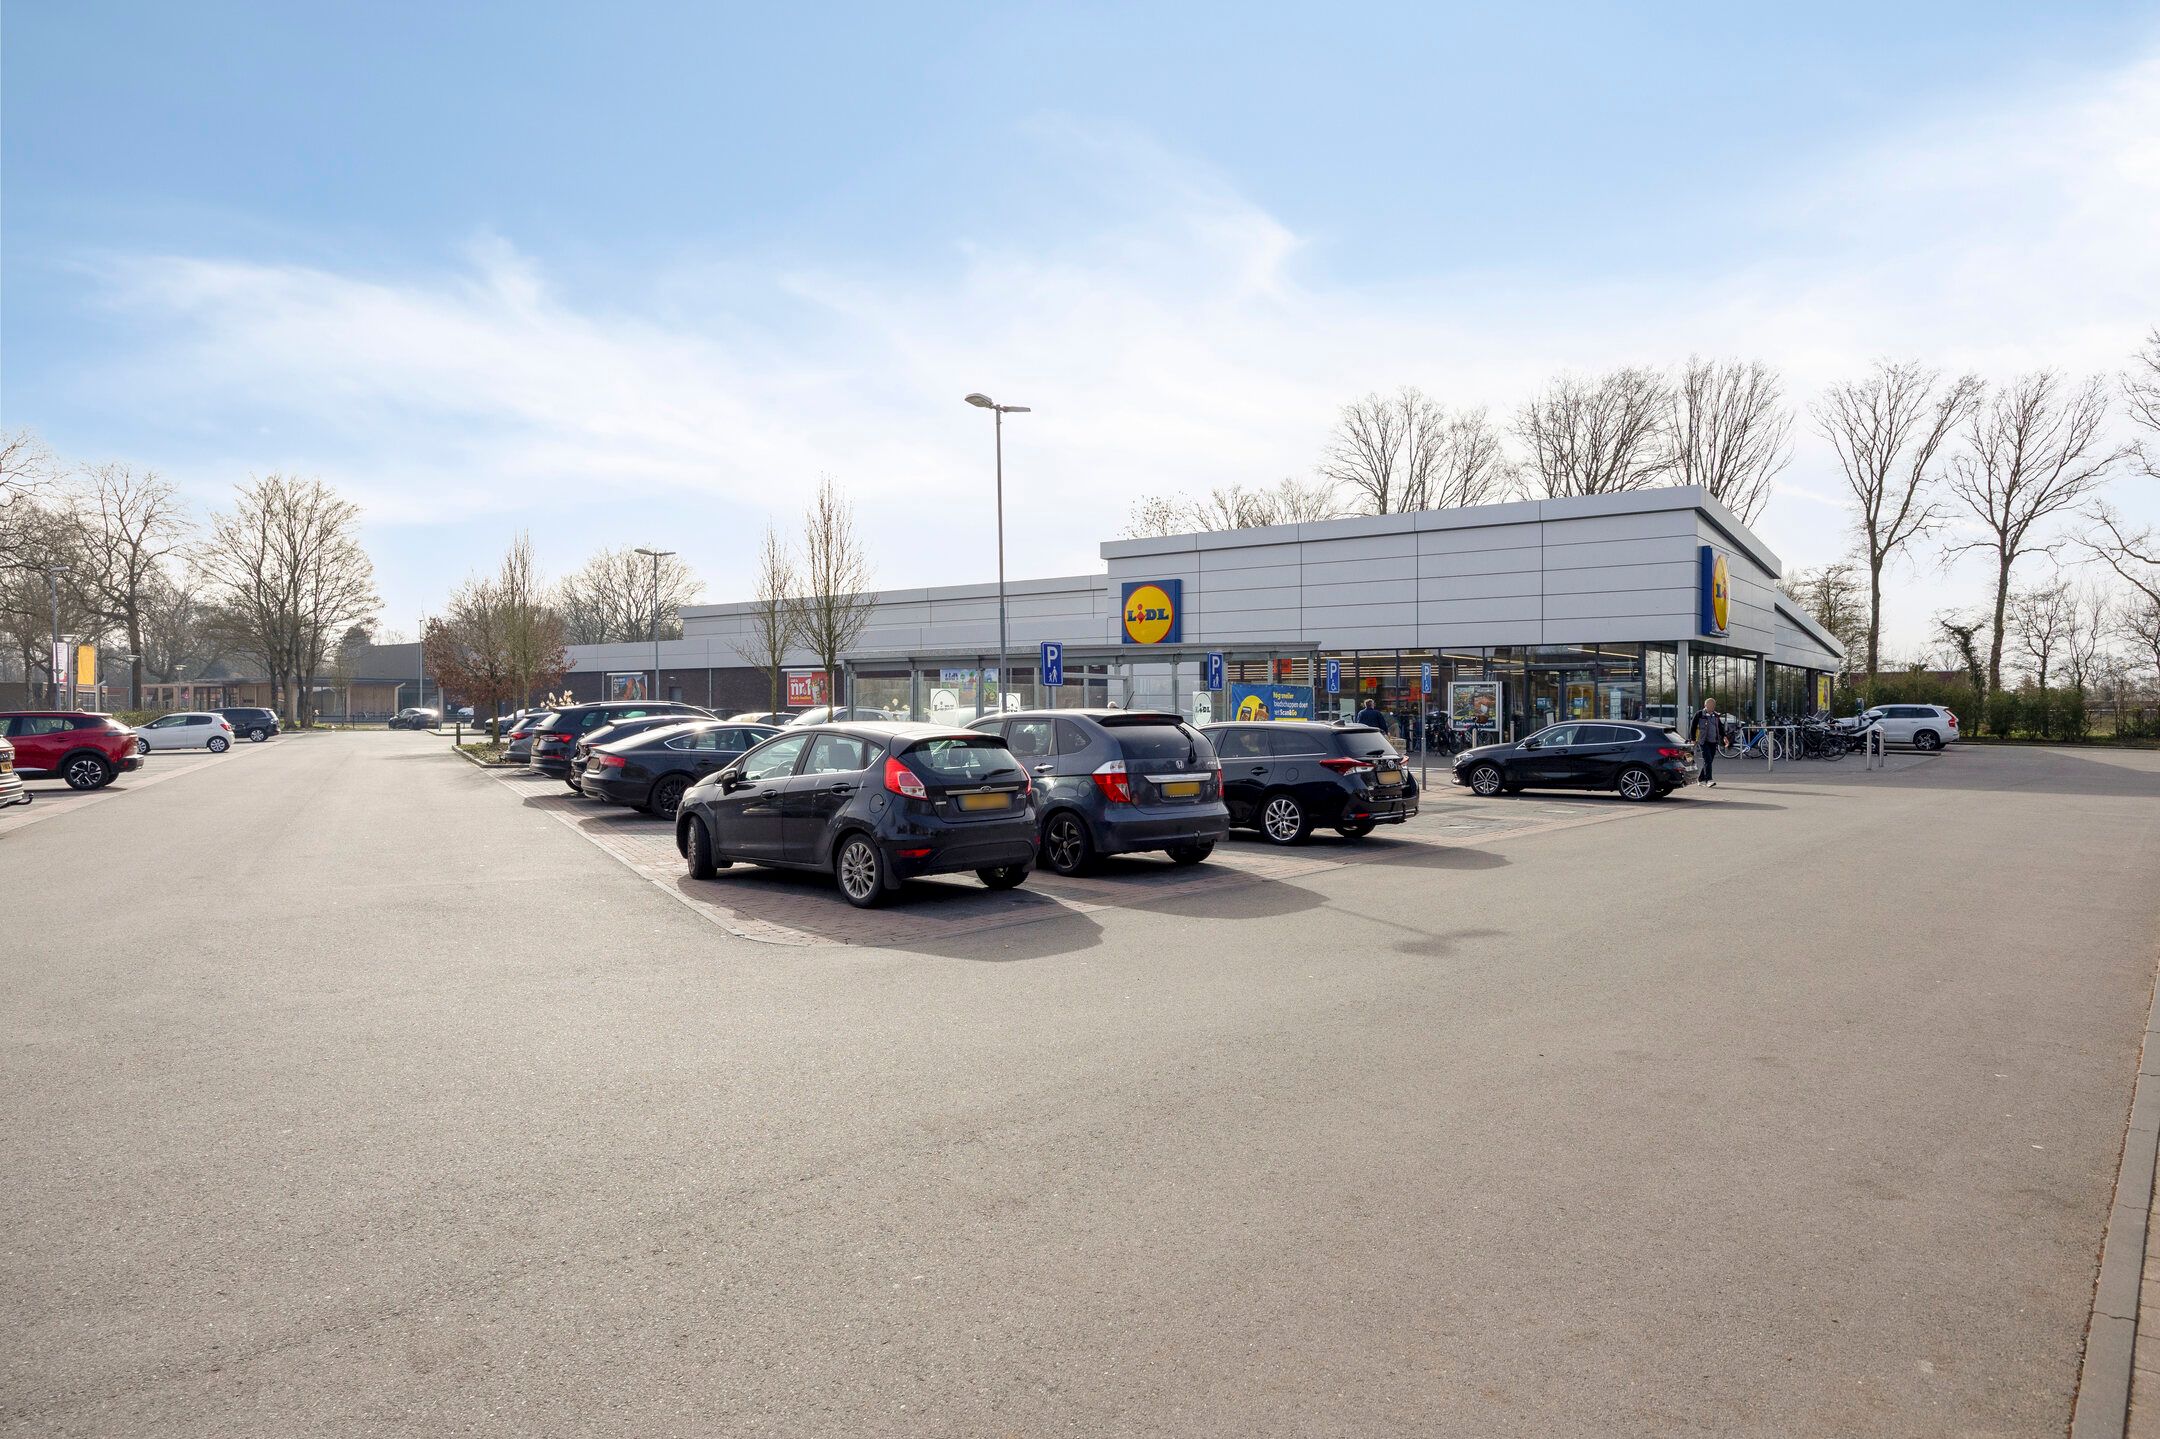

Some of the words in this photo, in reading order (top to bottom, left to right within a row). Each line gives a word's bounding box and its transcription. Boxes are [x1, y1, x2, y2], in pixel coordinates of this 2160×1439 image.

[1047, 646, 1058, 668] P
[1212, 655, 1220, 675] P
[1330, 662, 1338, 679] P
[1424, 665, 1430, 680] P
